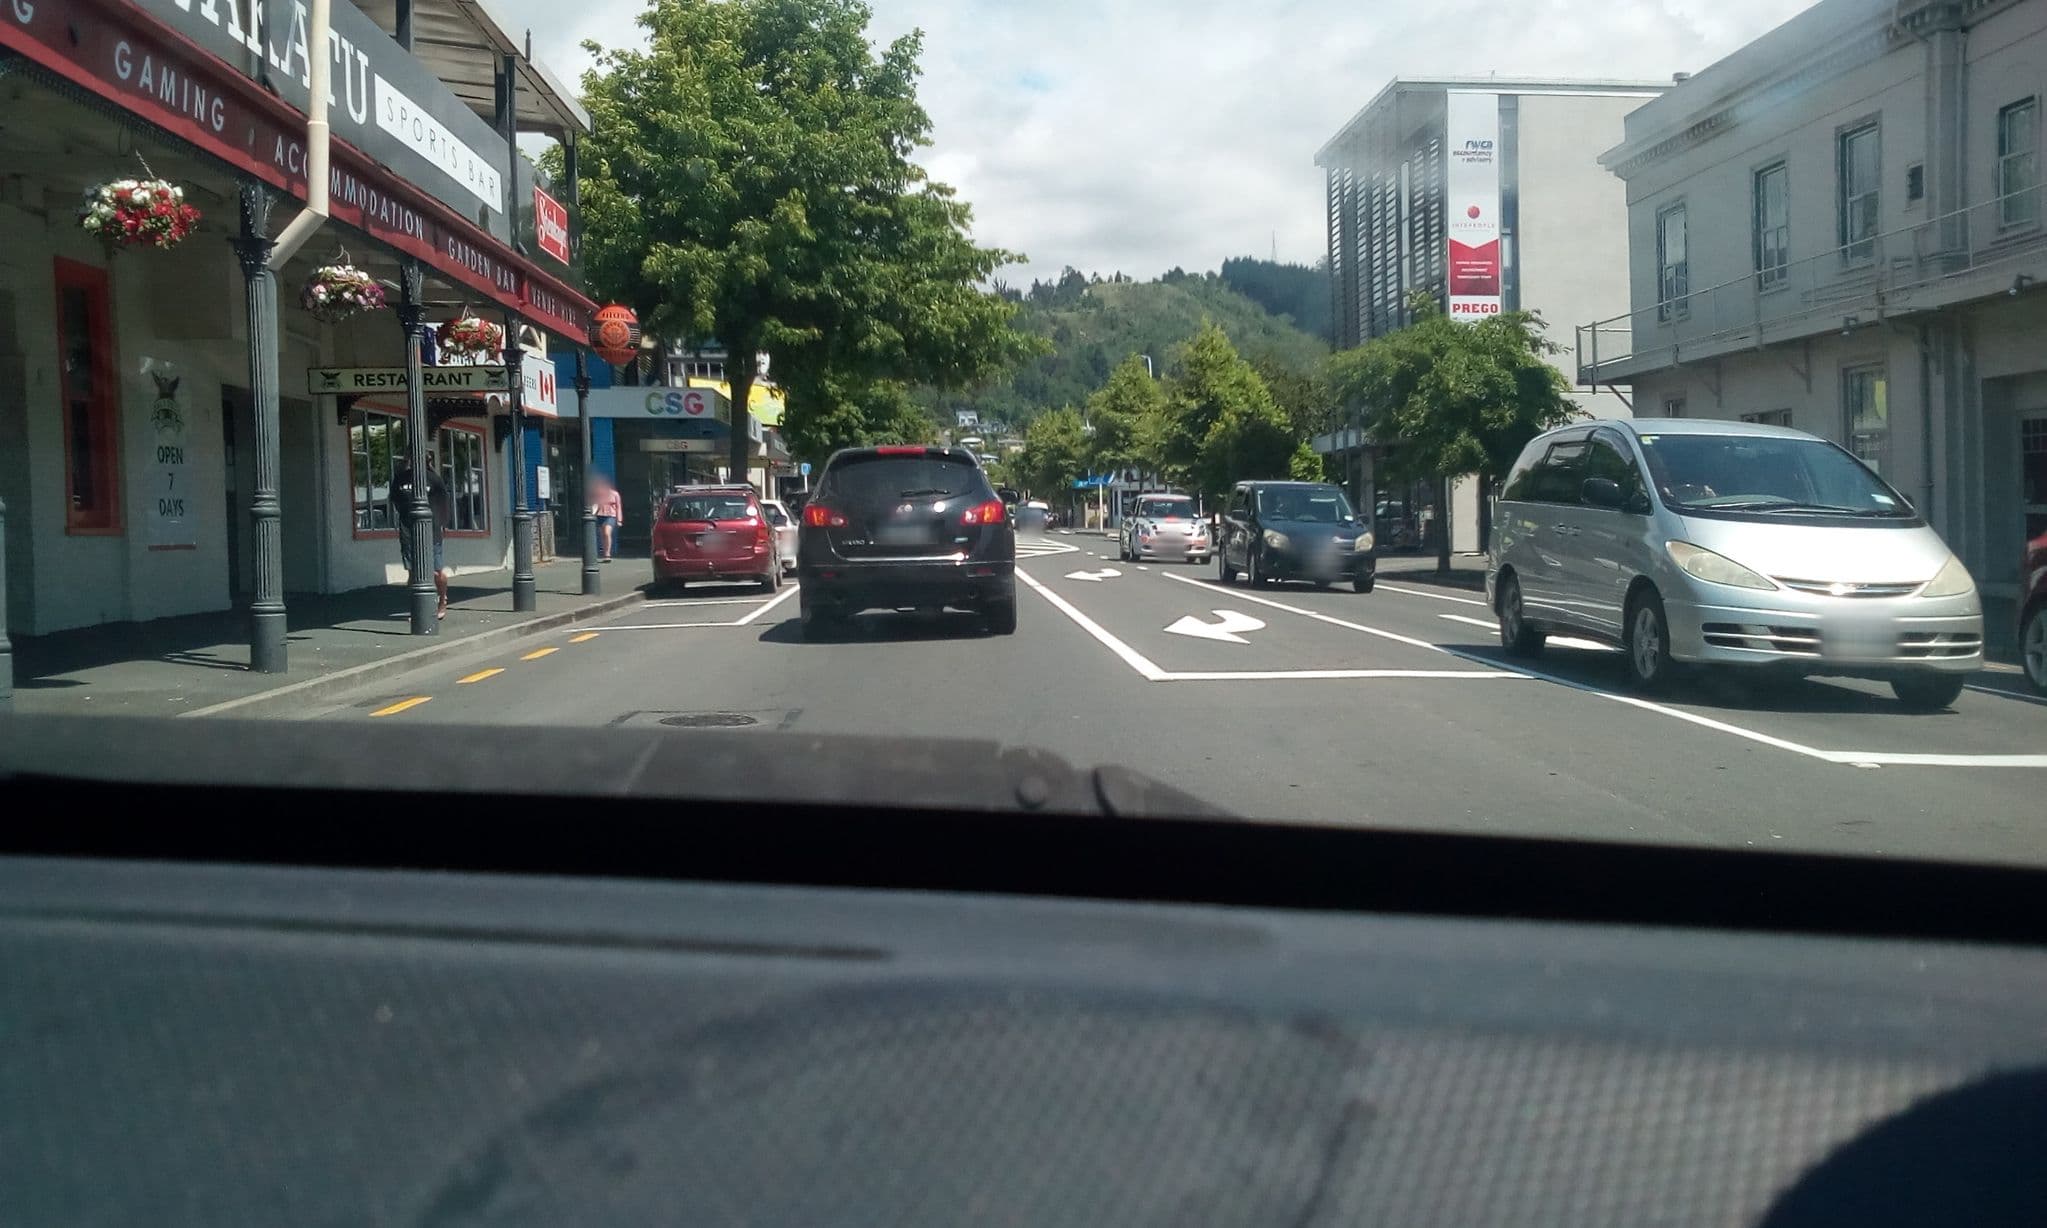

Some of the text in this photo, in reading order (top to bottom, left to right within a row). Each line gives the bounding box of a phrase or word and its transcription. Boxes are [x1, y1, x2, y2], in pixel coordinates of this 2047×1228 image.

[387, 96, 458, 169] SPORTS
[468, 159, 495, 198] BAR
[115, 41, 225, 131] GAMING
[275, 135, 424, 240] ACMMODATION
[448, 236, 491, 280] GARDEN
[496, 265, 515, 294] BAR
[1452, 303, 1499, 314] PREGO
[354, 372, 473, 387] RESTARANT
[645, 391, 705, 416] CSG
[157, 446, 184, 464] OPEN
[168, 473, 174, 490] 7
[159, 499, 184, 517] DAYS
